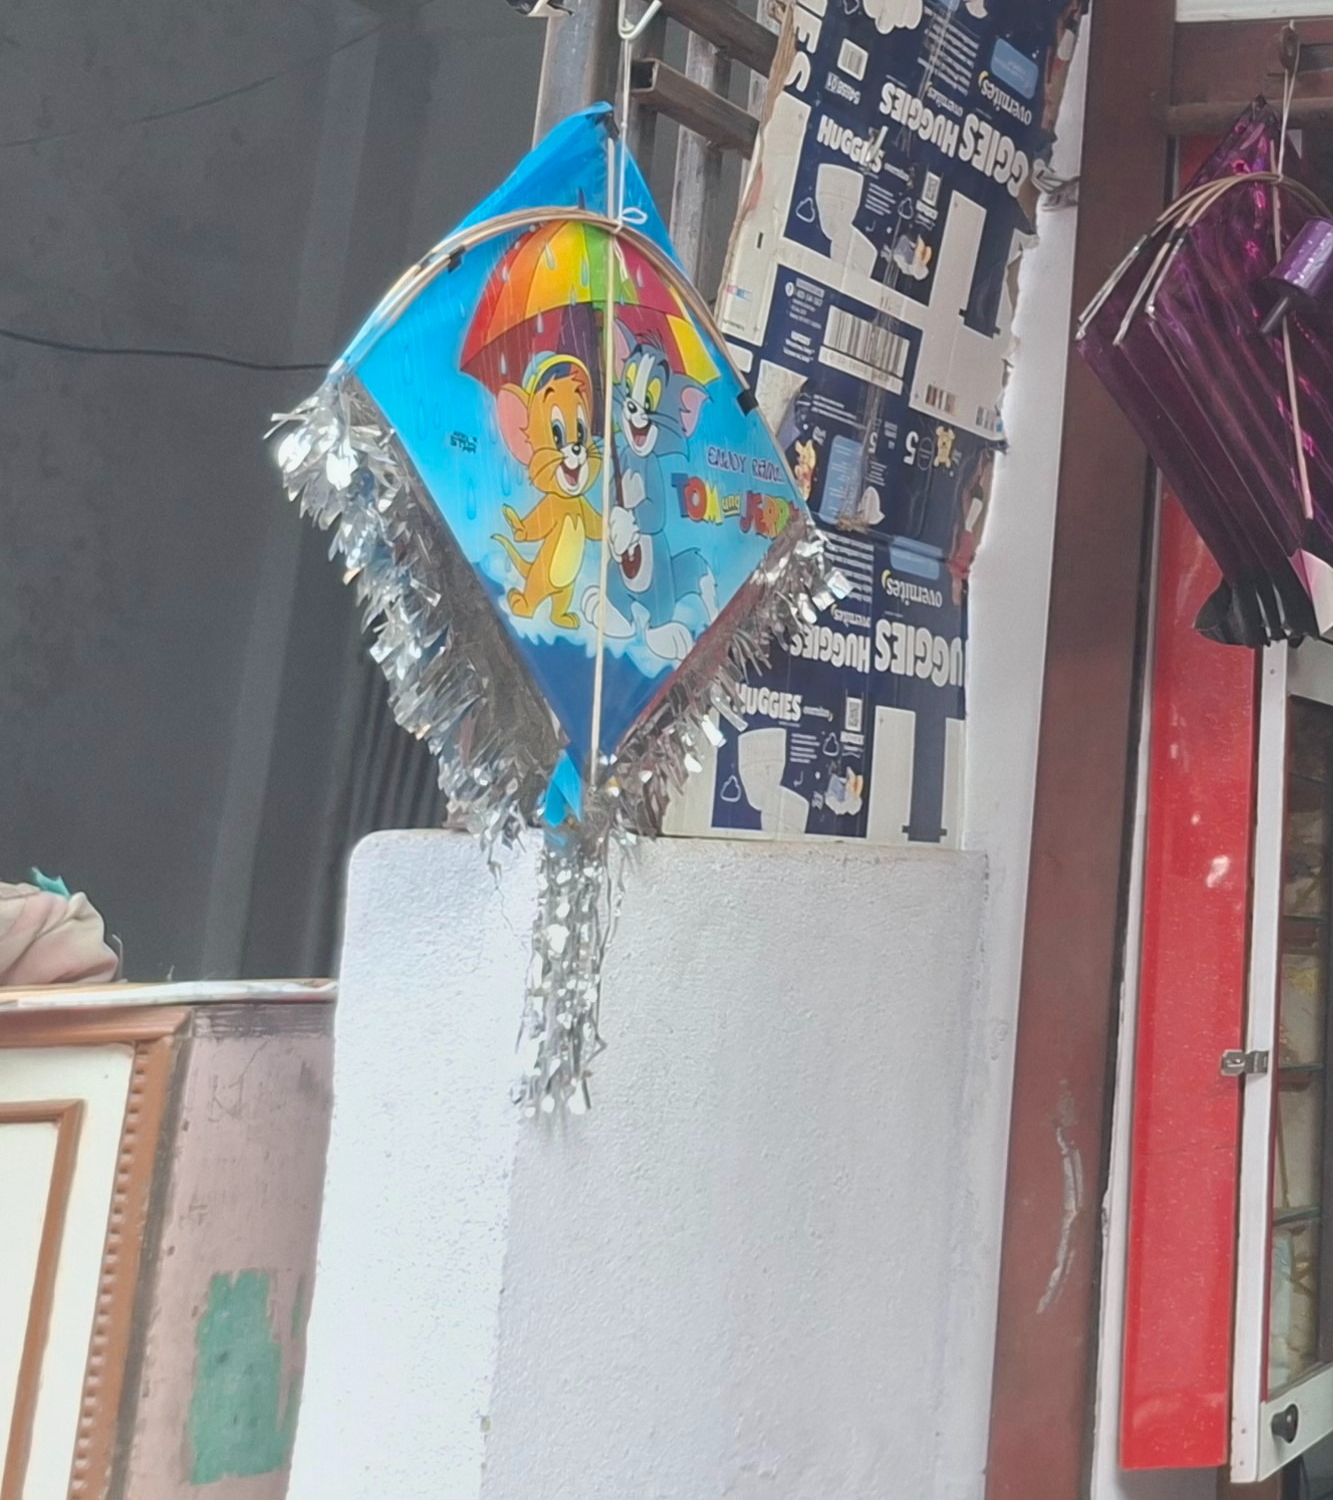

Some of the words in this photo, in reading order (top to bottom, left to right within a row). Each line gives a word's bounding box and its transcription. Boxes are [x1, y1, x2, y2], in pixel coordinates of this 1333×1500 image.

[879, 81, 960, 159] HUGGIES
[981, 79, 1032, 126] overnites
[670, 472, 723, 525] TOM
[886, 577, 943, 607] overnites
